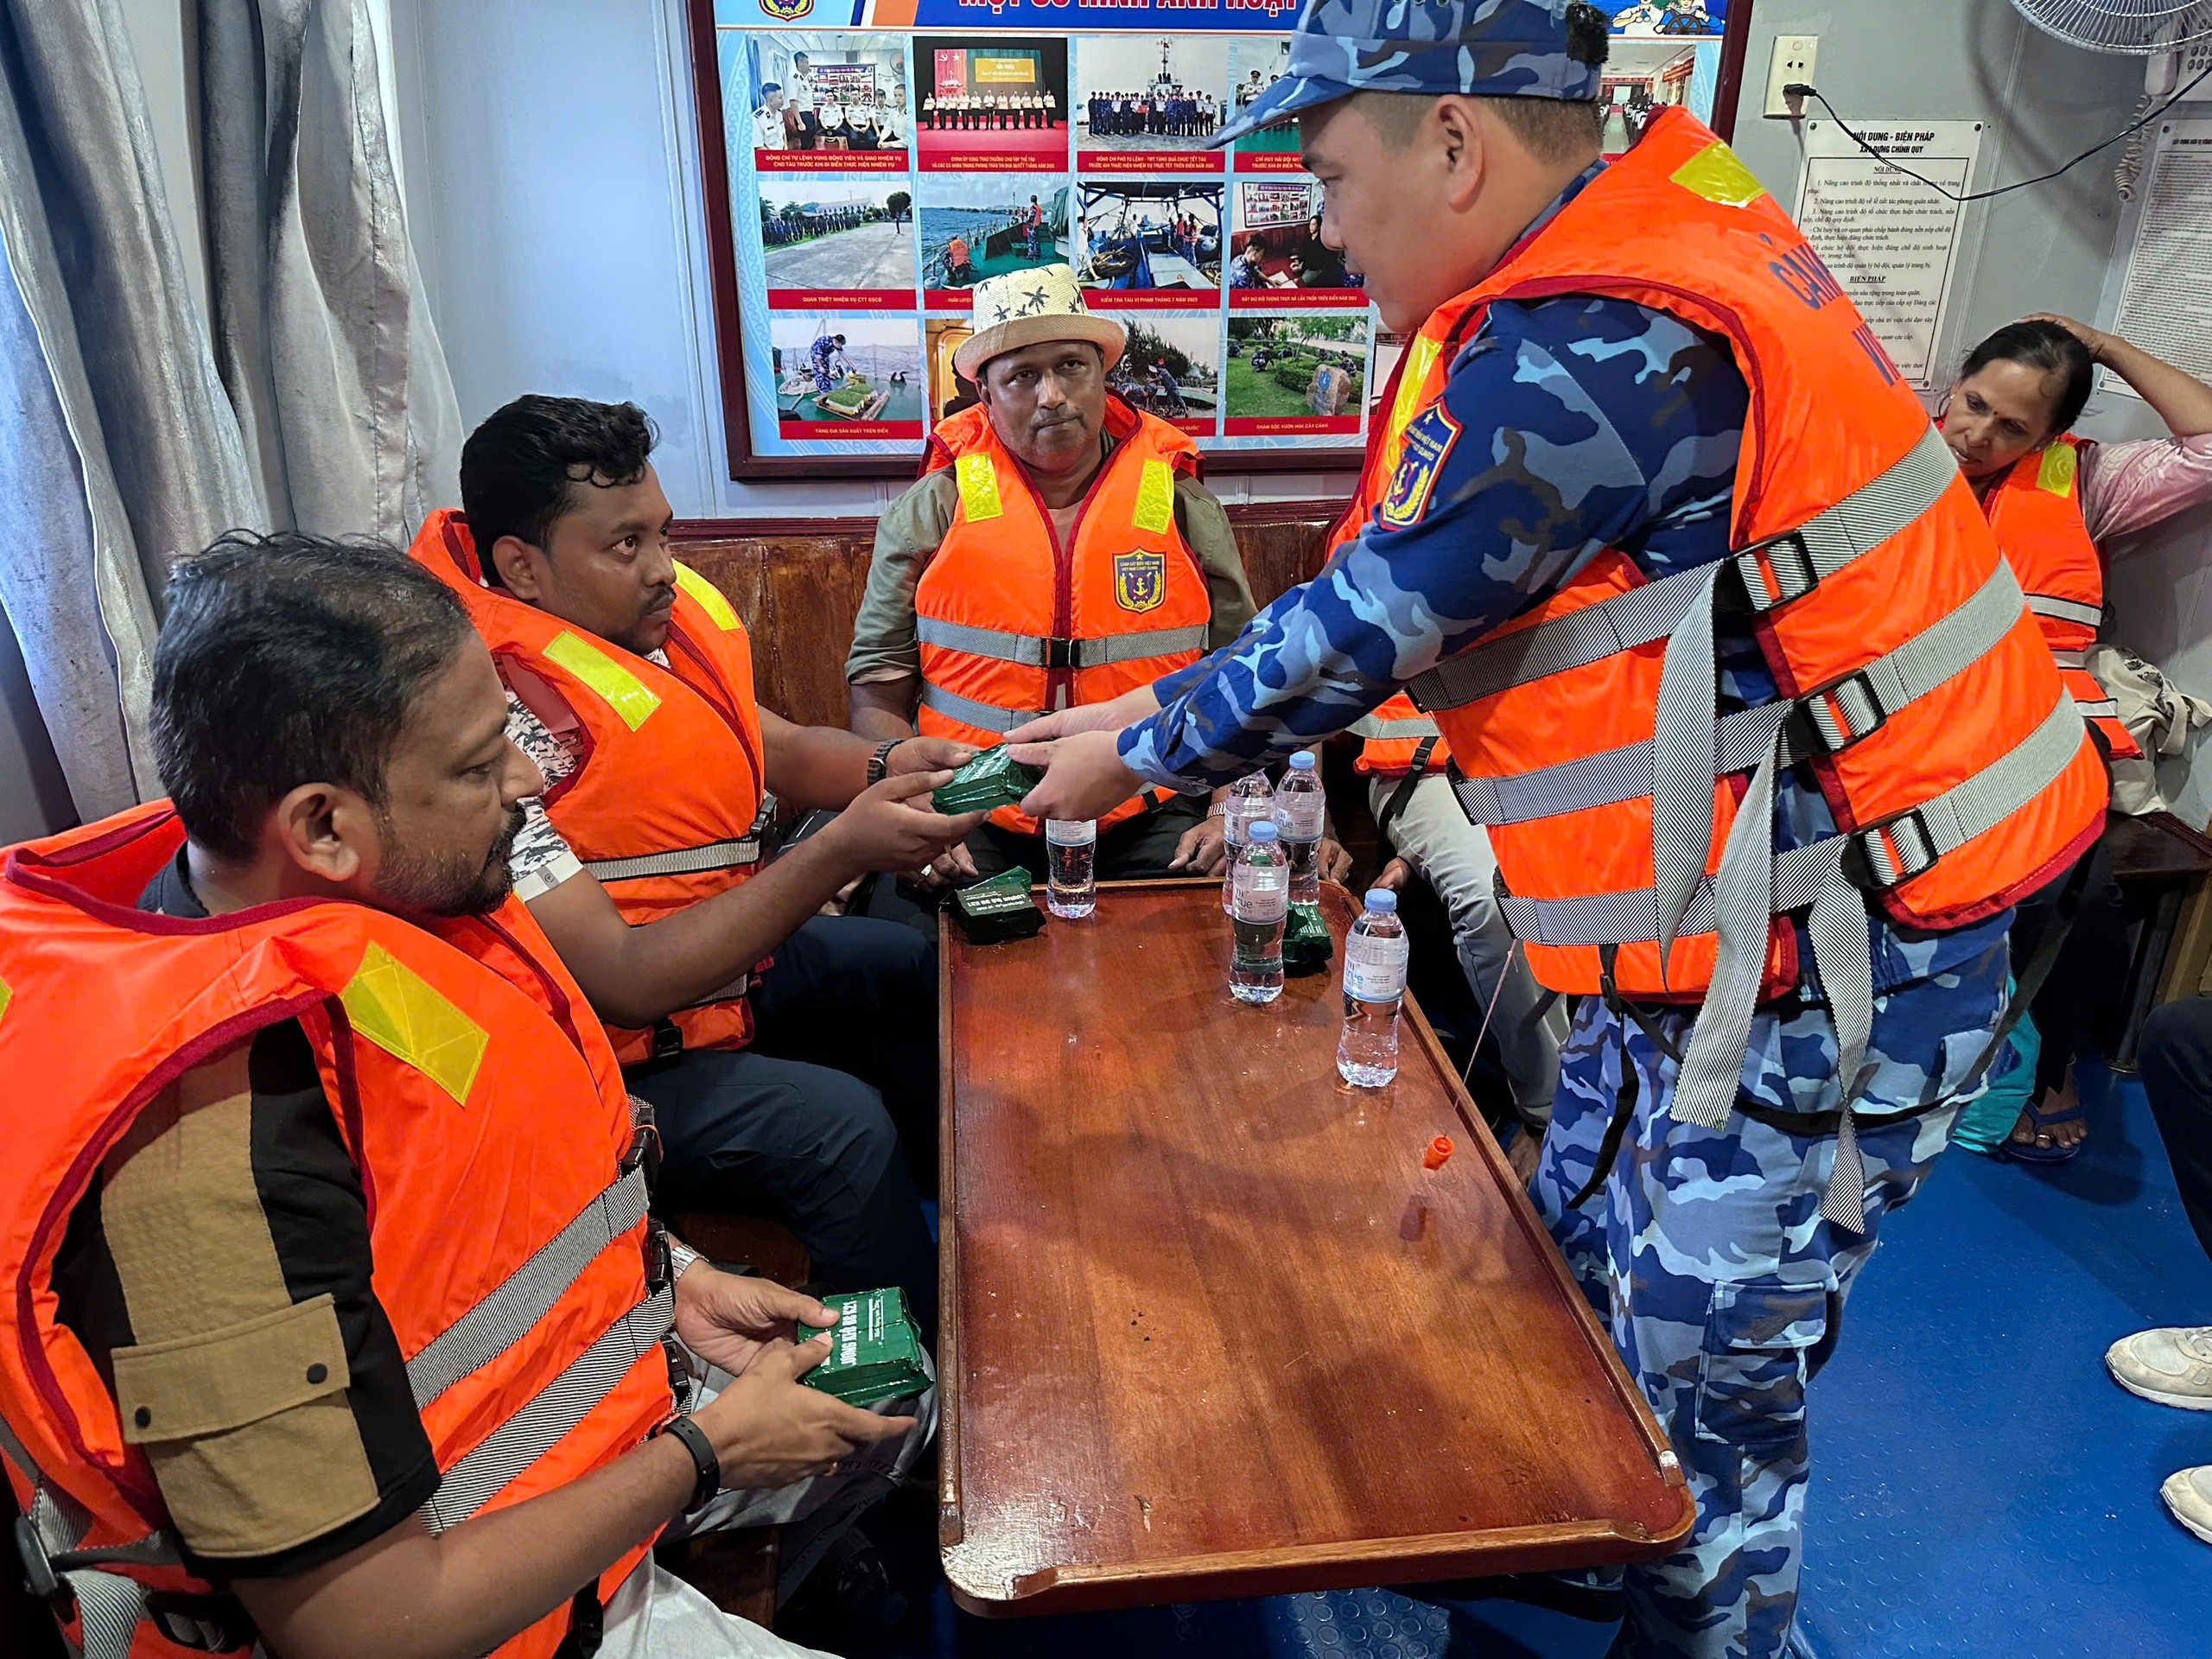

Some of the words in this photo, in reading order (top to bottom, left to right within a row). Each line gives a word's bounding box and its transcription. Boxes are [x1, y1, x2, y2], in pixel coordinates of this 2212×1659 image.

[1867, 132, 1889, 141] DUNG
[1895, 130, 1913, 143] BIỆN
[1914, 130, 1935, 141] PHÁP
[1891, 144, 1910, 153] CHÍNH
[1911, 145, 1924, 154] QUY
[842, 1300, 857, 1316] K21
